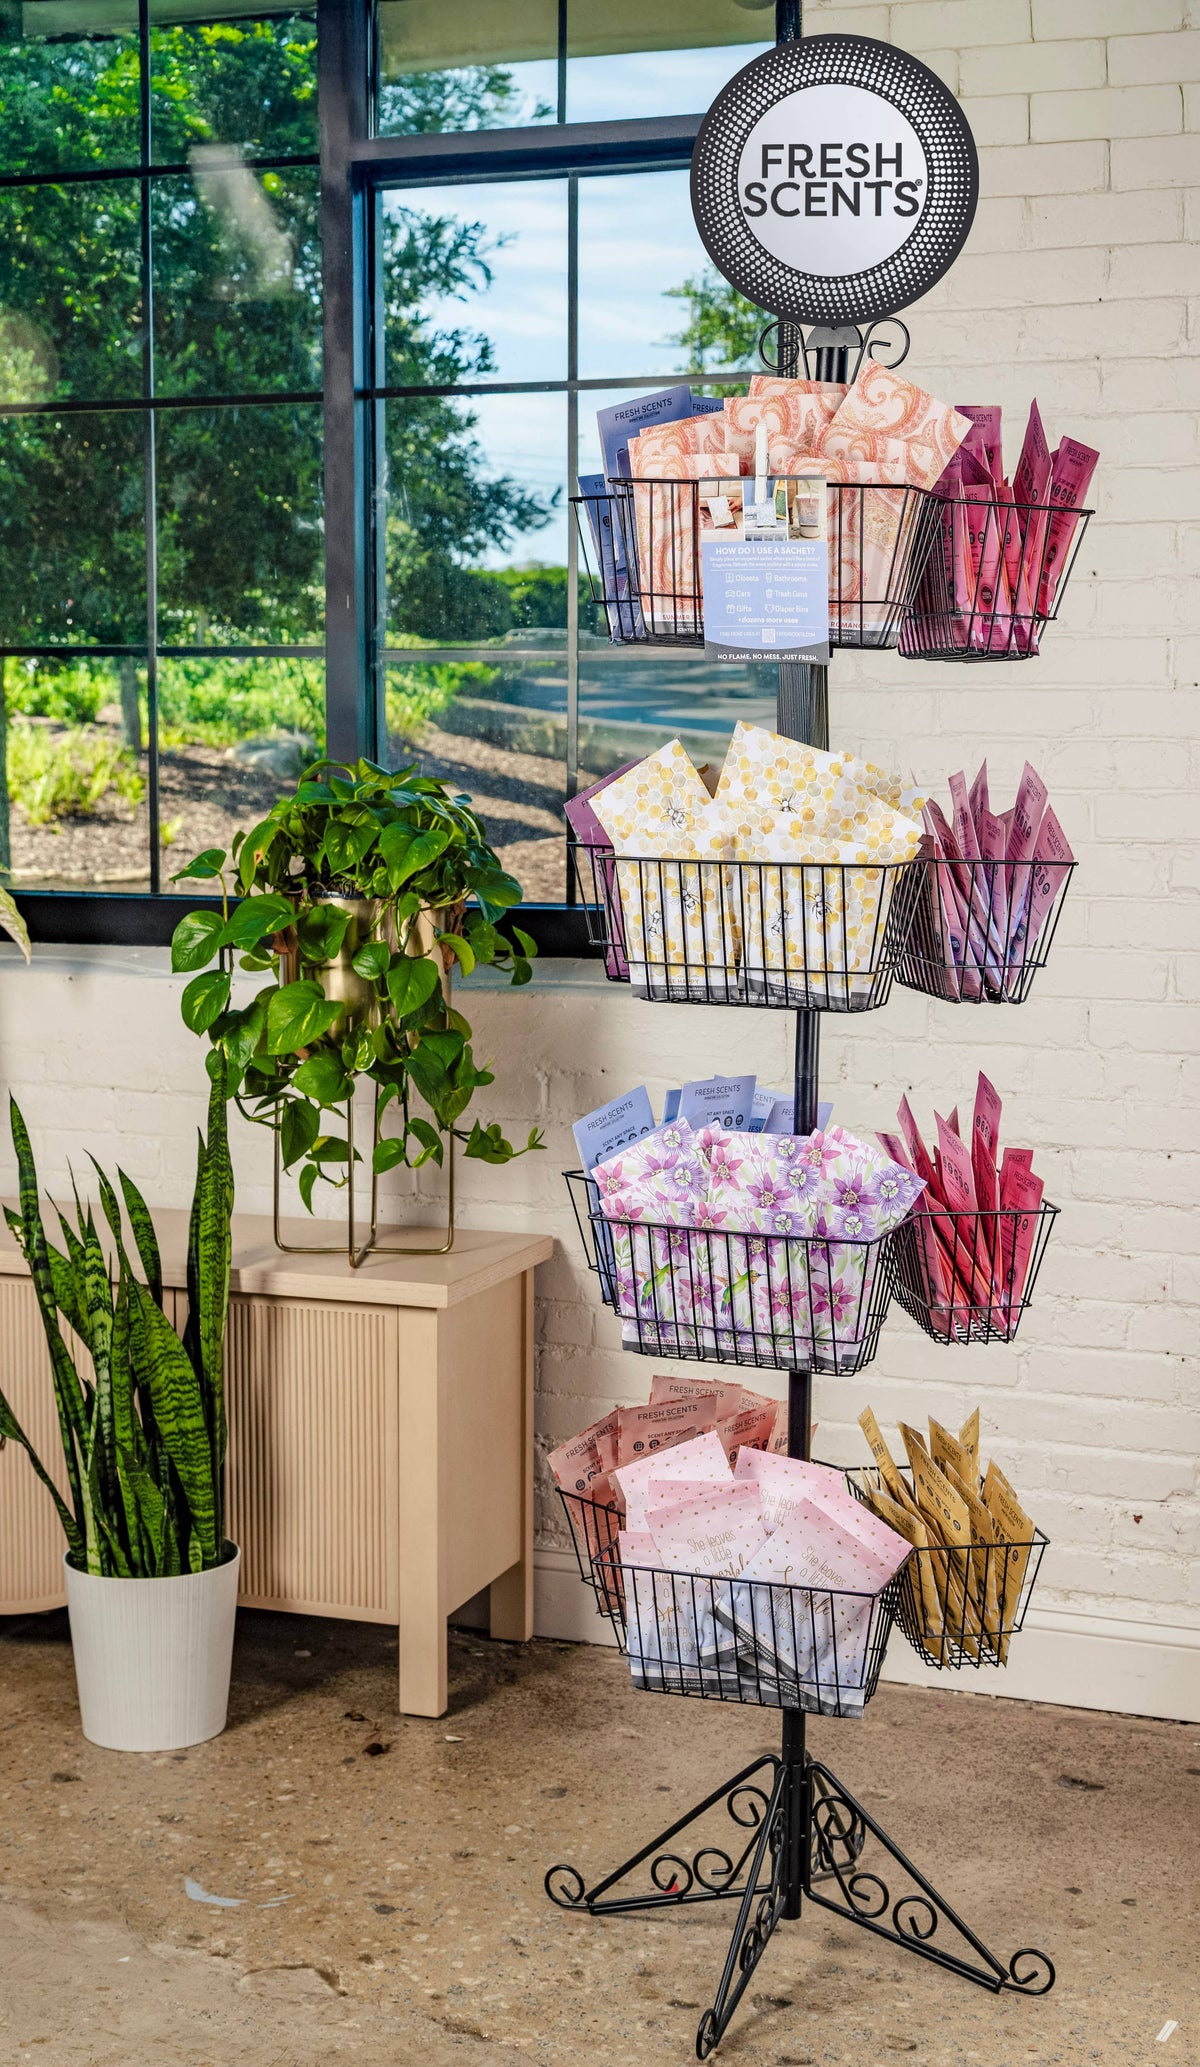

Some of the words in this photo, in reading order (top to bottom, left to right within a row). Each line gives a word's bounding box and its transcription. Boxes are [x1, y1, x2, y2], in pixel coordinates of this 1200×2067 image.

[761, 142, 903, 179] FRESH
[614, 408, 640, 421] FRESH
[641, 398, 673, 414] SCENTS
[692, 403, 714, 413] FRESH
[715, 547, 736, 555] HOW
[738, 547, 751, 555] DO
[781, 547, 816, 555] SACHET?
[735, 574, 760, 582] Closets
[774, 574, 807, 582] Bathrooms
[736, 590, 751, 598] Cars
[775, 590, 792, 598] Trash
[793, 590, 808, 598] Cans
[775, 605, 795, 613] Diaper
[796, 605, 809, 613] Bins
[790, 982, 813, 991] HAPY
[695, 1086, 715, 1096] FRESH
[716, 1084, 741, 1094] SCENTS
[587, 1115, 608, 1131] FRESH
[607, 1100, 634, 1119] SCENTS
[755, 1347, 783, 1356] LOWR
[669, 1385, 694, 1394] FRESH
[638, 1411, 664, 1420] FRESH
[666, 1404, 698, 1415] SCENTS
[723, 1422, 743, 1434] FRESH
[743, 1413, 766, 1427] SCENTS
[565, 1441, 588, 1460] FRESH
[588, 1423, 614, 1445] SCENTS
[760, 1489, 776, 1506] She
[779, 1494, 800, 1512] leav
[764, 1510, 771, 1521] a
[687, 1538, 706, 1554] She
[705, 1529, 737, 1548] leaves
[703, 1555, 711, 1566] a
[710, 1548, 733, 1564] little
[801, 1545, 819, 1567] She
[818, 1560, 847, 1588] leaves
[800, 1567, 808, 1578] a
[808, 1571, 829, 1589] little
[773, 1565, 831, 1616] Srkle
